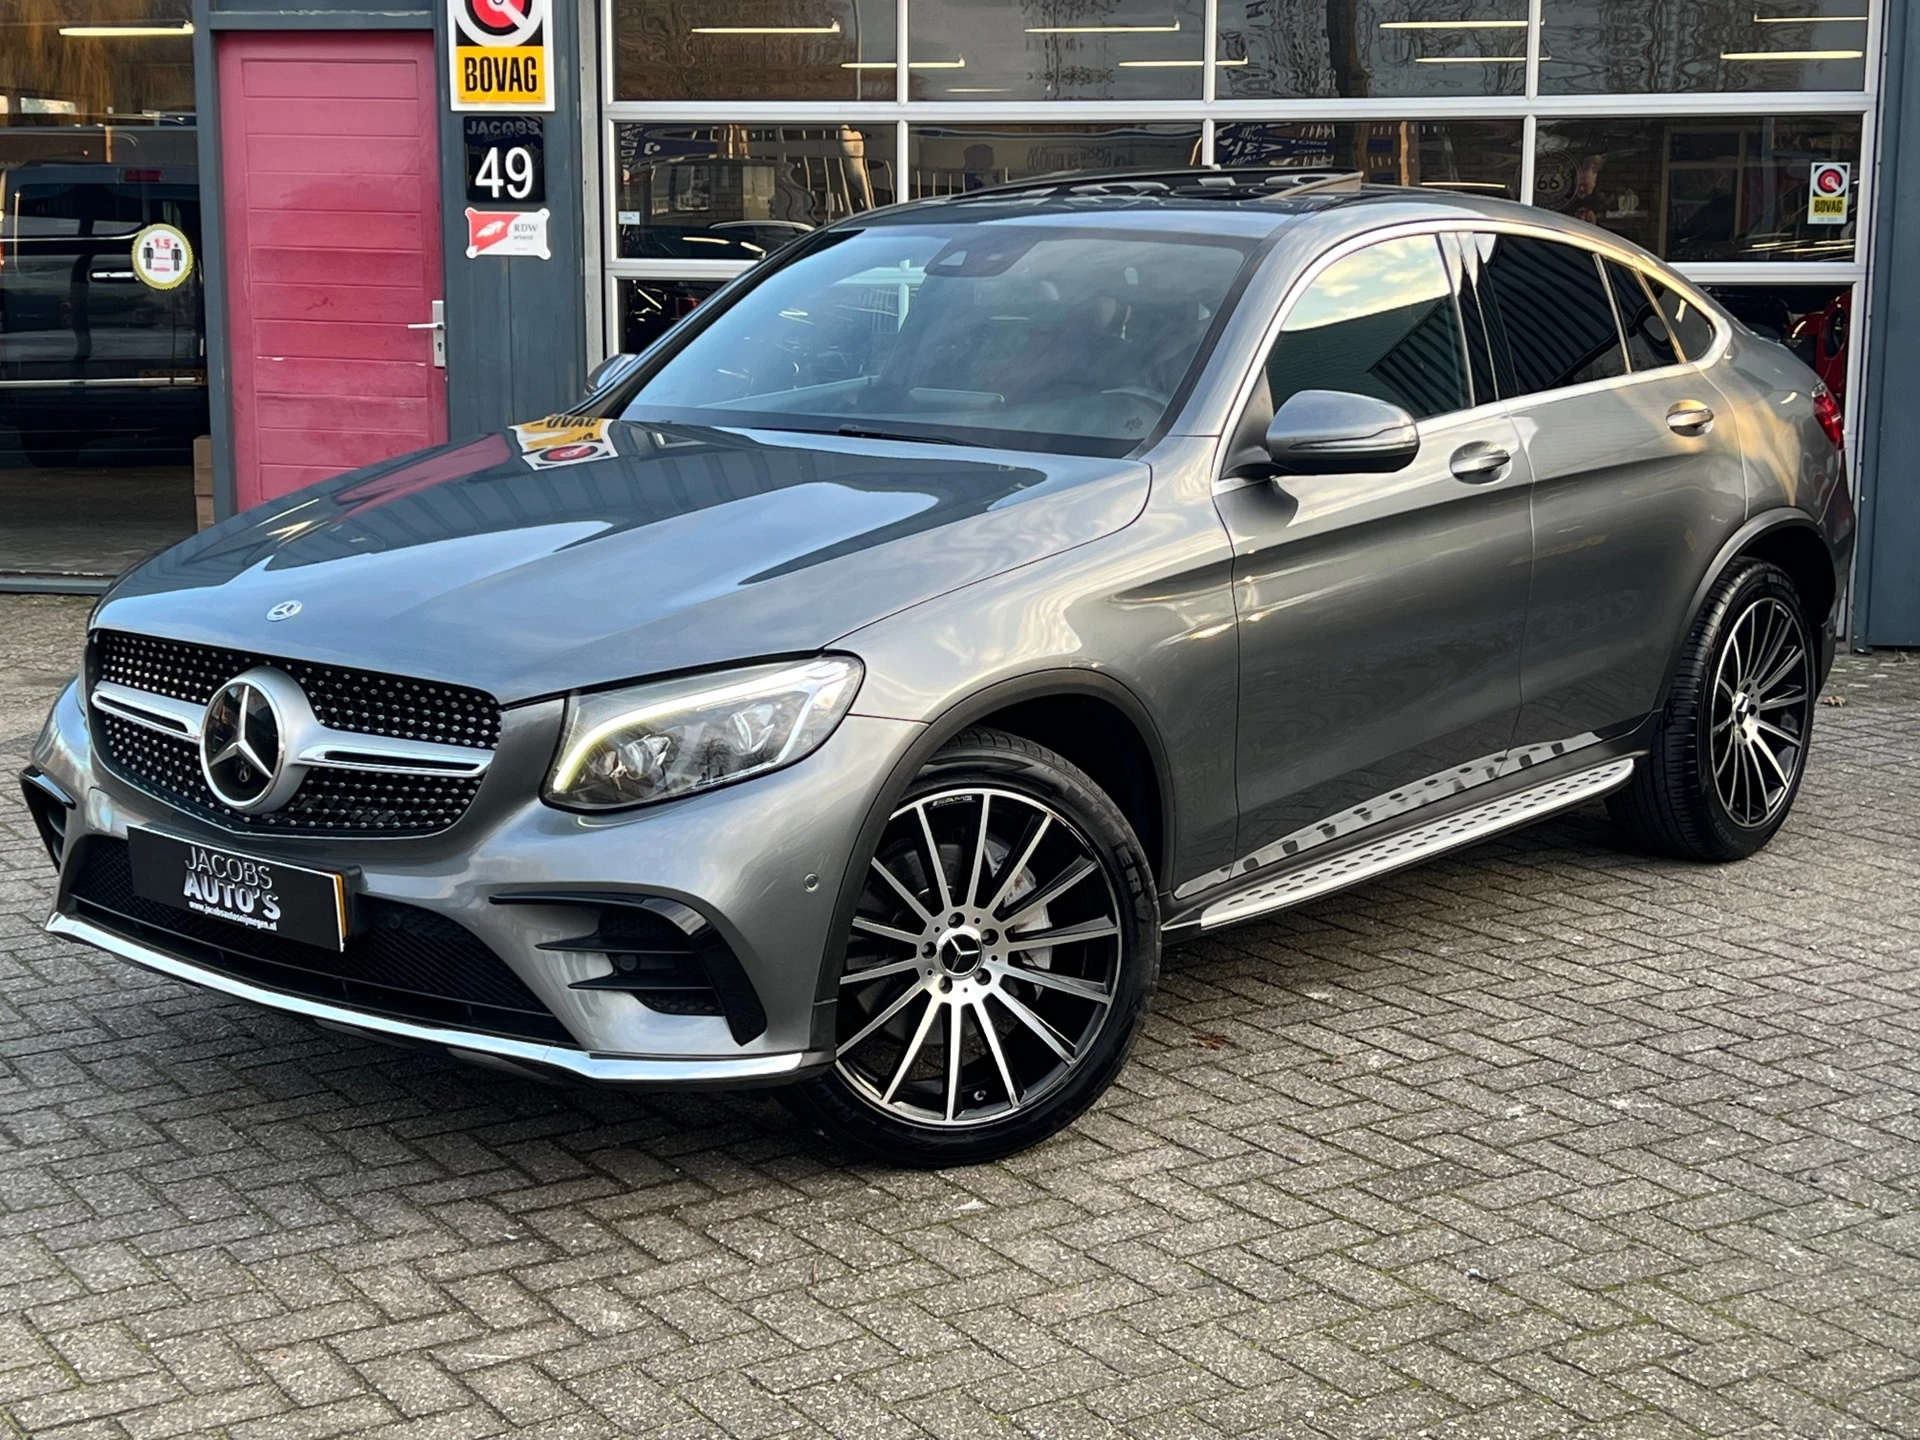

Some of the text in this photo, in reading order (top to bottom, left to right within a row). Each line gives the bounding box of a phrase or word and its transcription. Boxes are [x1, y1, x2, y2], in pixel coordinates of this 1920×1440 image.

[464, 57, 537, 93] BOVAG
[466, 121, 540, 135] JACOBS
[475, 146, 534, 199] 49
[1537, 174, 1559, 190] 66
[1814, 200, 1843, 213] BOVAG
[514, 224, 538, 232] RDW
[154, 239, 171, 249] 1.5
[185, 846, 272, 889] JACOBS
[184, 871, 281, 920] AUTO'S
